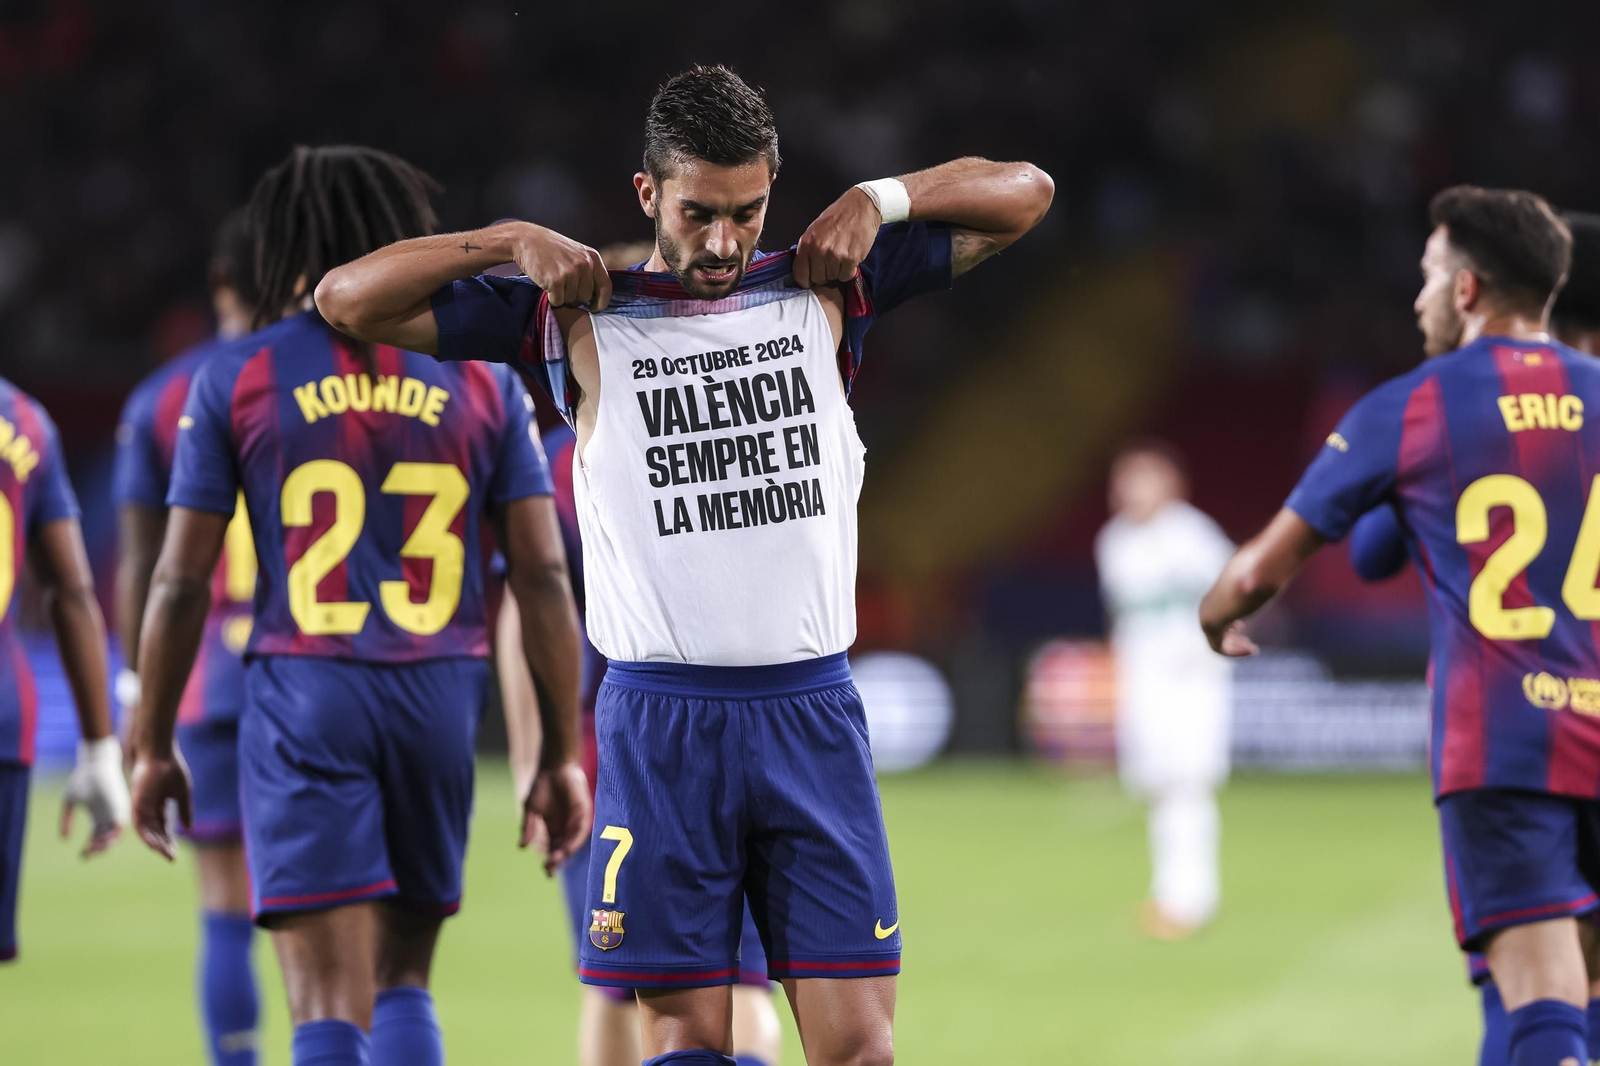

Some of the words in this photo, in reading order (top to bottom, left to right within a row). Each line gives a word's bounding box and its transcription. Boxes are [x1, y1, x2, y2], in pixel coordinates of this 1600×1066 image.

[632, 359, 658, 380] 29
[661, 345, 753, 376] OCTUBRE
[755, 334, 804, 363] 2024
[293, 373, 450, 427] KOUNDE
[636, 366, 816, 438] VALÈNCIA
[1498, 394, 1584, 432] ERIC
[645, 430, 780, 488] SEMPRE
[783, 423, 821, 470] EN
[653, 496, 694, 537] LA
[697, 478, 826, 532] MEMÒRIA
[281, 459, 471, 635] 23
[600, 825, 634, 904] 7
